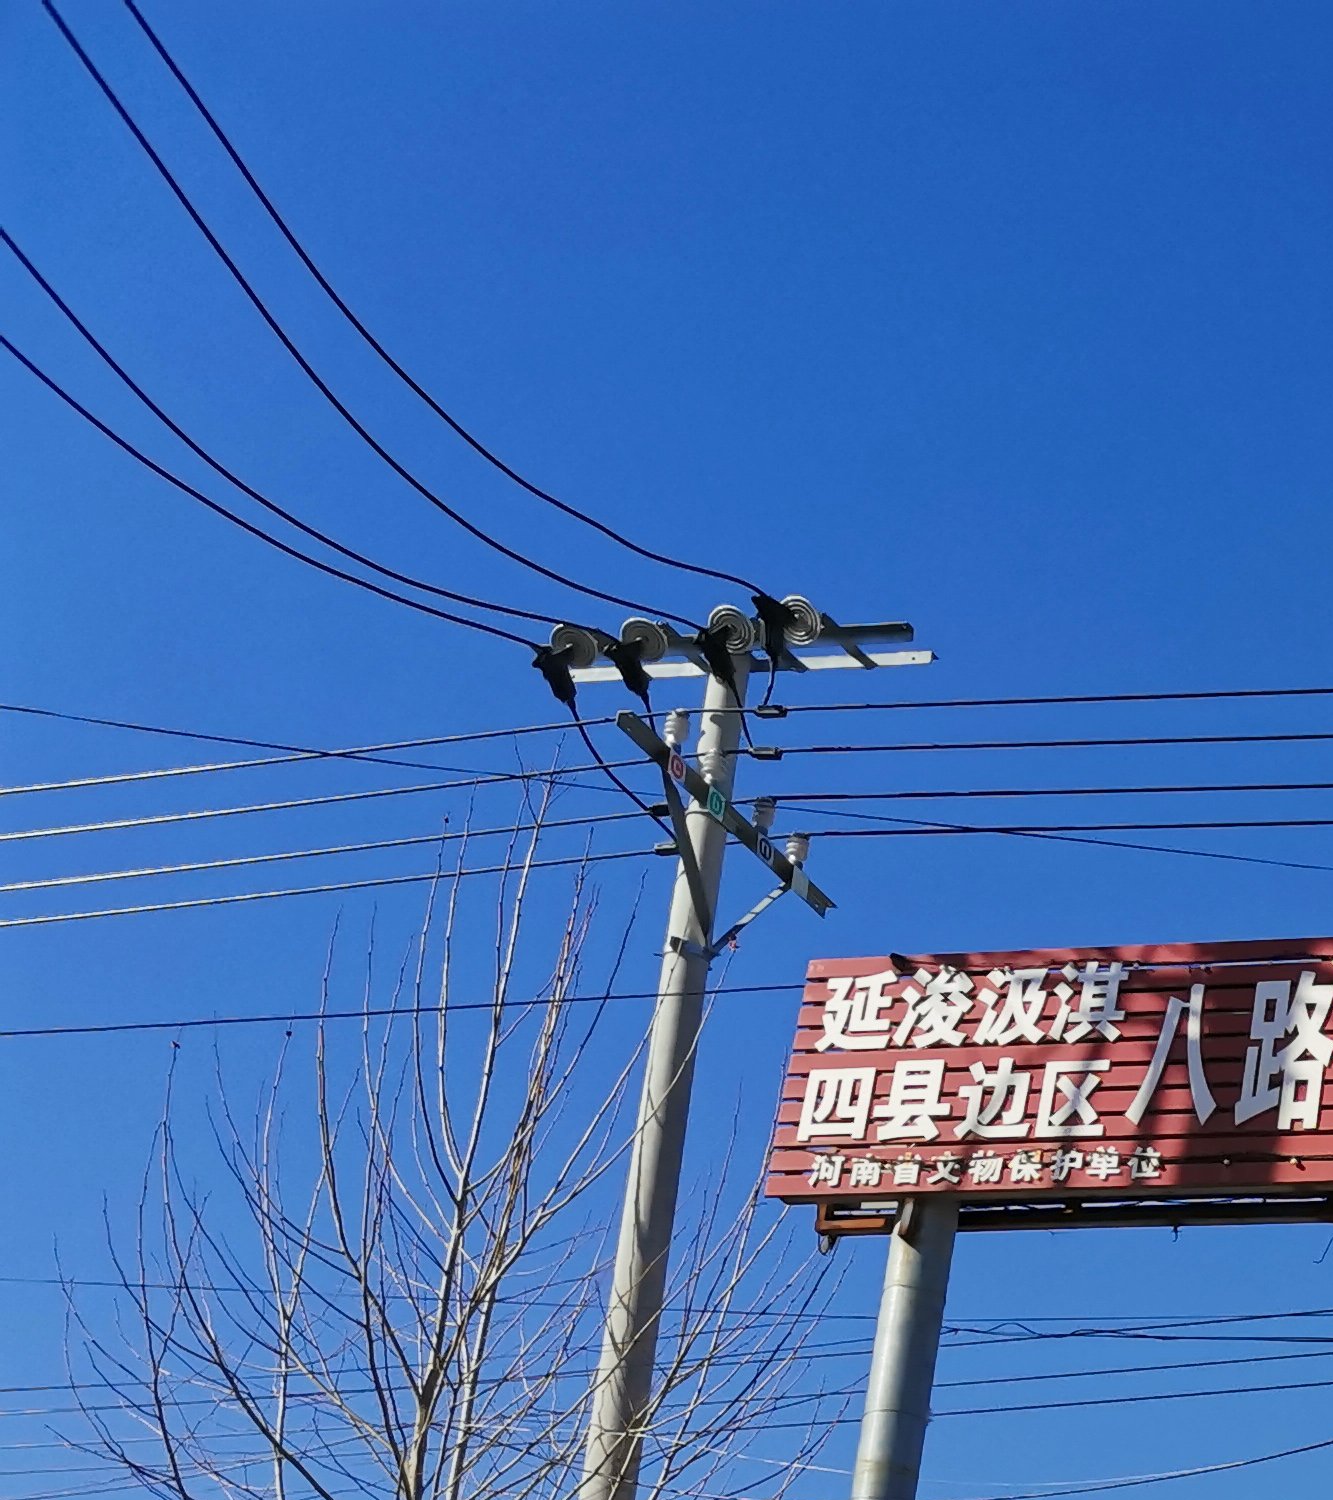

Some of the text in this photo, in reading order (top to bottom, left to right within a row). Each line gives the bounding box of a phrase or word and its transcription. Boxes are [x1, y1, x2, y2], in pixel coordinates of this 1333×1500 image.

[814, 962, 1130, 1052] 延浚汲淇
[799, 1057, 1112, 1142] 四县边区
[807, 1147, 1164, 1188] 河南省文物保护单位
